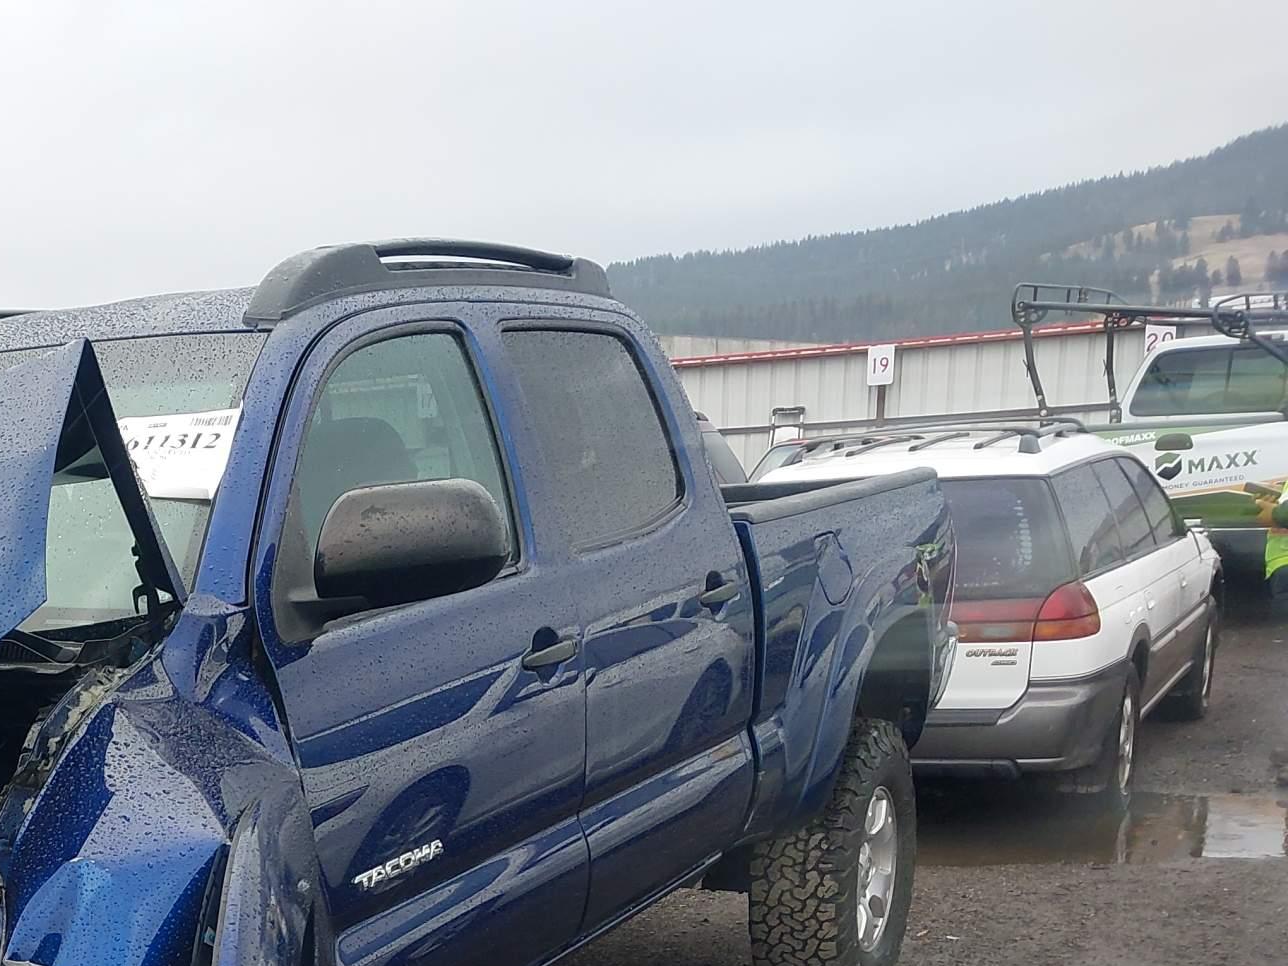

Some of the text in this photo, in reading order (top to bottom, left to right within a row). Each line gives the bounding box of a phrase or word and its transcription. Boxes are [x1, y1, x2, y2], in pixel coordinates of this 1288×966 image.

[872, 357, 889, 374] 19
[125, 432, 222, 451] 611312
[1187, 450, 1258, 474] MAXX
[1192, 474, 1245, 487] GUARANTEED
[965, 647, 1019, 658] OUTBACK
[351, 839, 444, 891] TACOMA
